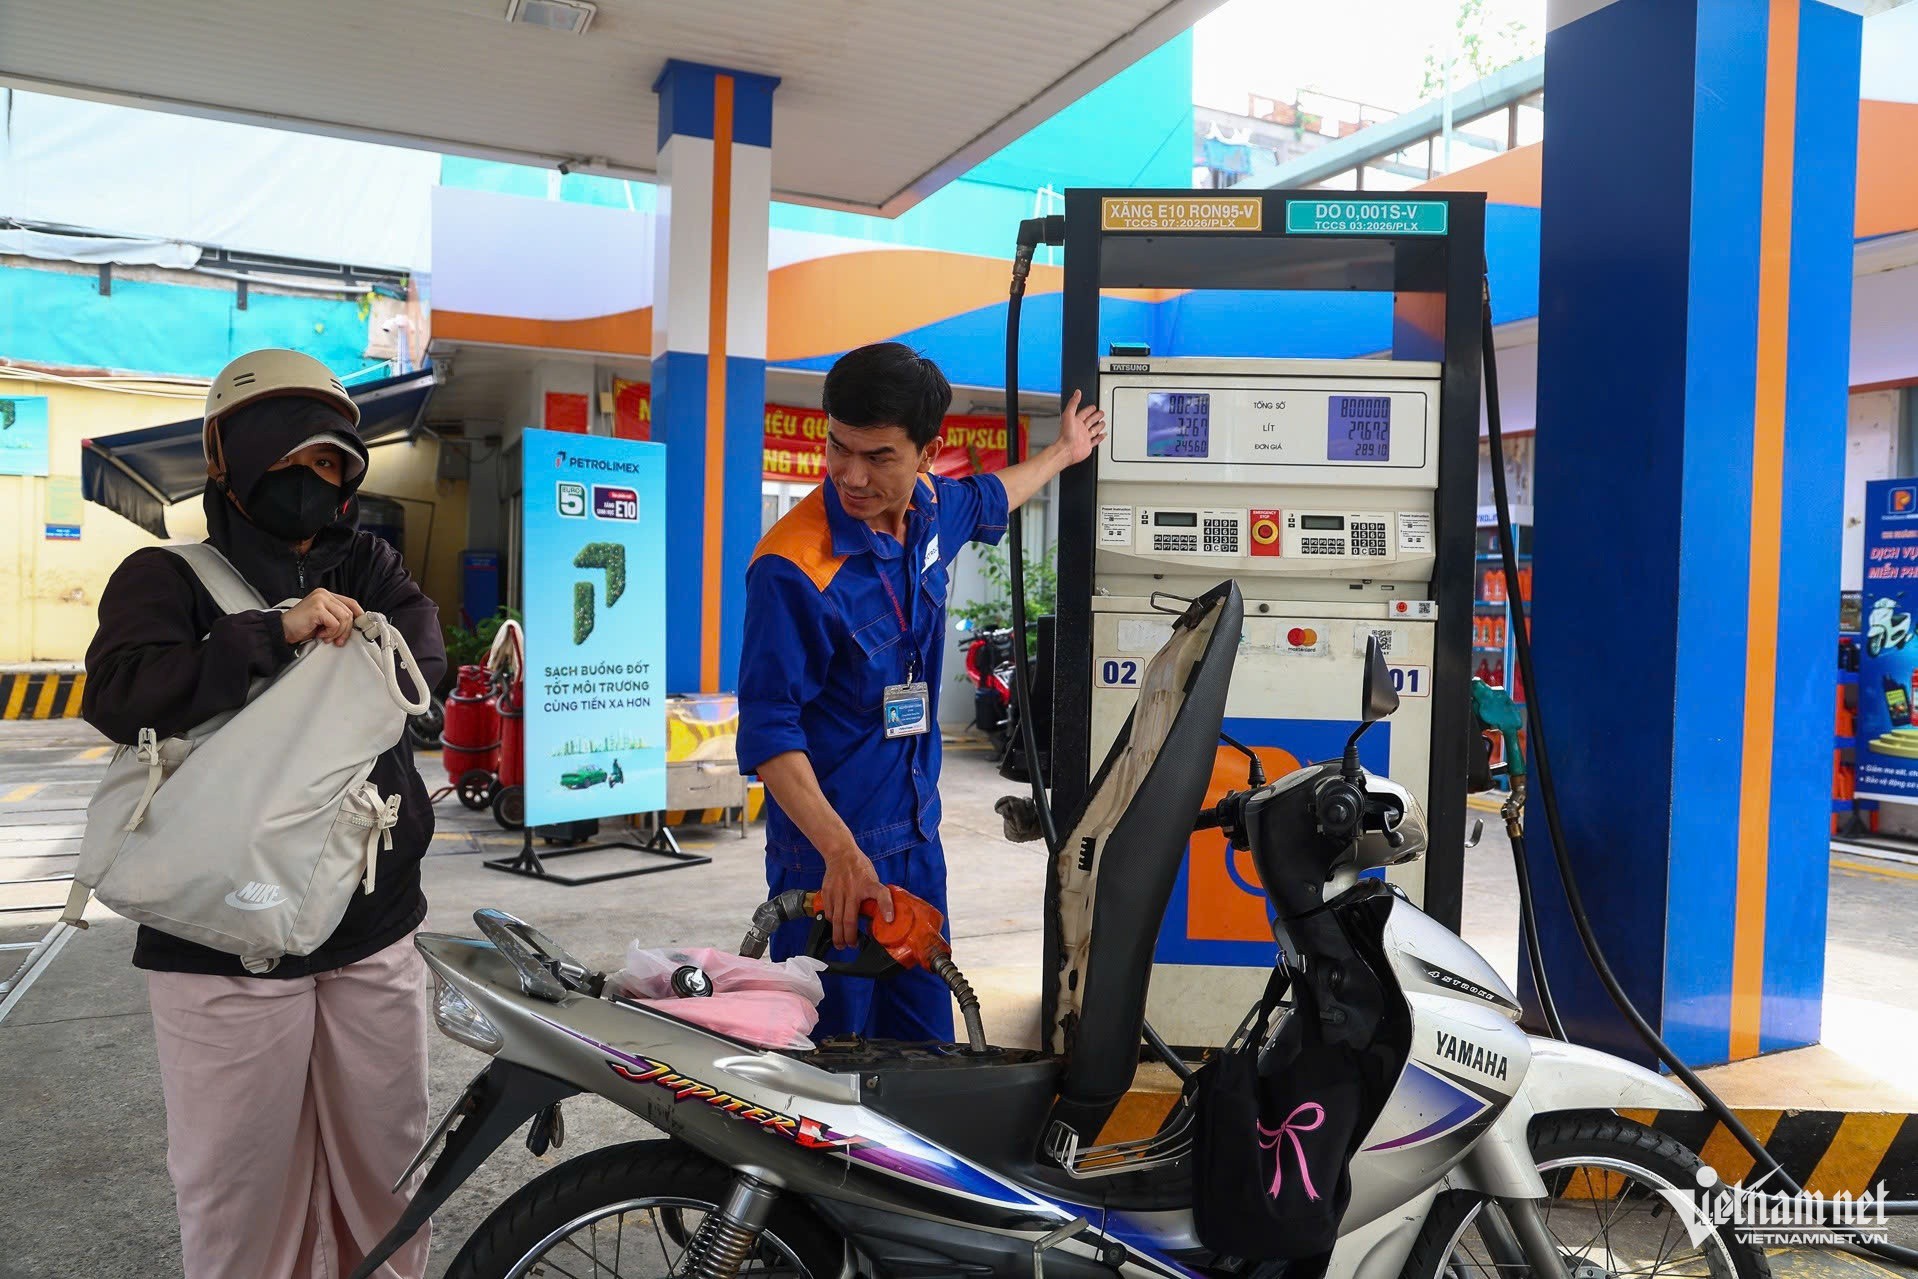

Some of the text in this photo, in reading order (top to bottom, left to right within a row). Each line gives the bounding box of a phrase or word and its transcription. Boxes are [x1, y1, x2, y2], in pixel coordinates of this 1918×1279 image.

[1110, 200, 1254, 219] XĂNG E10 RON95-V
[1315, 204, 1418, 221] DO 0,001S-V
[1124, 219, 1236, 228] TCCS 07:2026/PLX
[1315, 221, 1418, 231] TCCS 03:2026/PLX
[1112, 364, 1149, 372] TATSUNO
[1253, 401, 1286, 410] TỔNG SỐ
[1341, 399, 1389, 418] 800000
[1262, 424, 1275, 432] LÍT
[1175, 440, 1207, 453] 24560
[1355, 443, 1388, 456] 28910
[569, 457, 640, 474] PETROLIMEX
[560, 493, 584, 515] 5
[615, 501, 636, 518] E10
[1222, 536, 1228, 544] 3
[1868, 562, 1900, 578] MIỄN
[544, 665, 578, 681] SẠCH
[626, 660, 650, 675] ĐỐT
[1103, 660, 1137, 685] 02
[544, 680, 569, 696] TỐT
[572, 680, 596, 694] MÔI
[1389, 668, 1419, 693] 01
[543, 697, 651, 713] CÙNG TIẾN XA HƠN
[237, 881, 280, 904] NIKE
[1436, 1030, 1508, 1081] YAMAHA
